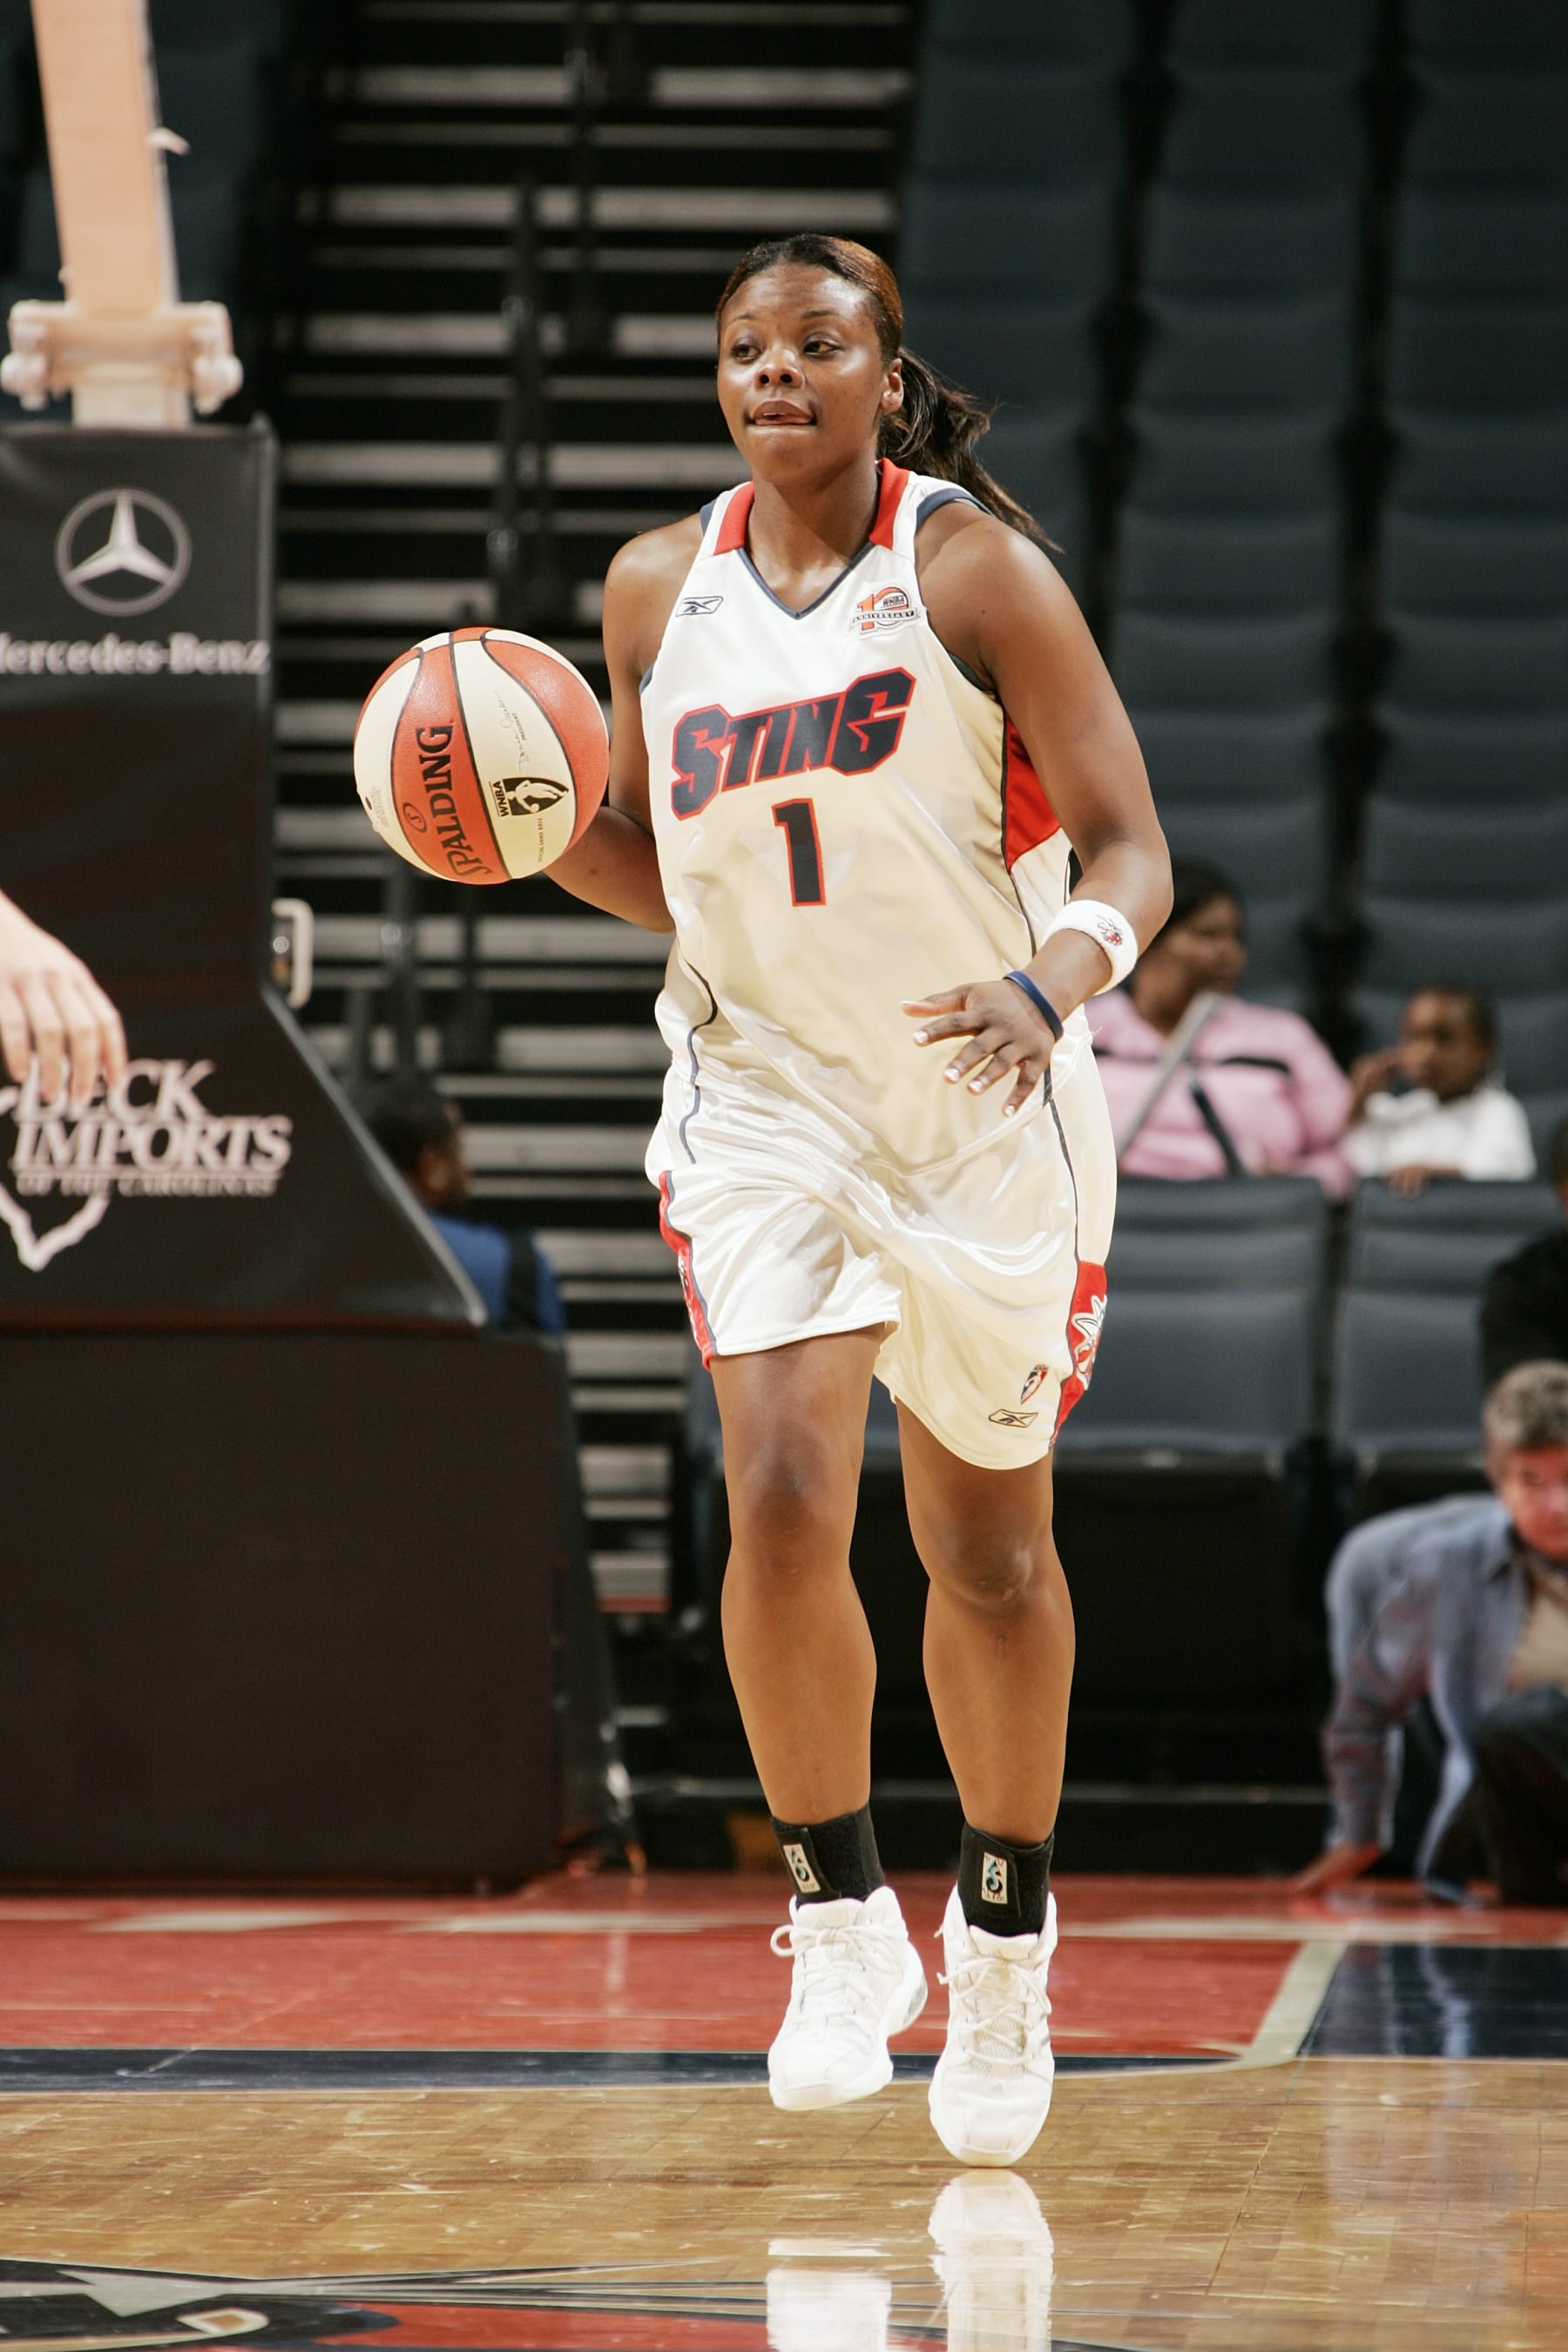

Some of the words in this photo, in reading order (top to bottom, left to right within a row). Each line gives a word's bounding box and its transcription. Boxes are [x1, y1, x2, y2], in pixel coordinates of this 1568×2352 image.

[671, 666, 916, 821] STING
[416, 725, 494, 876] SPALDING
[493, 781, 510, 817] WNBA
[772, 797, 827, 907] 1
[10, 1115, 293, 1172] IMPORTS
